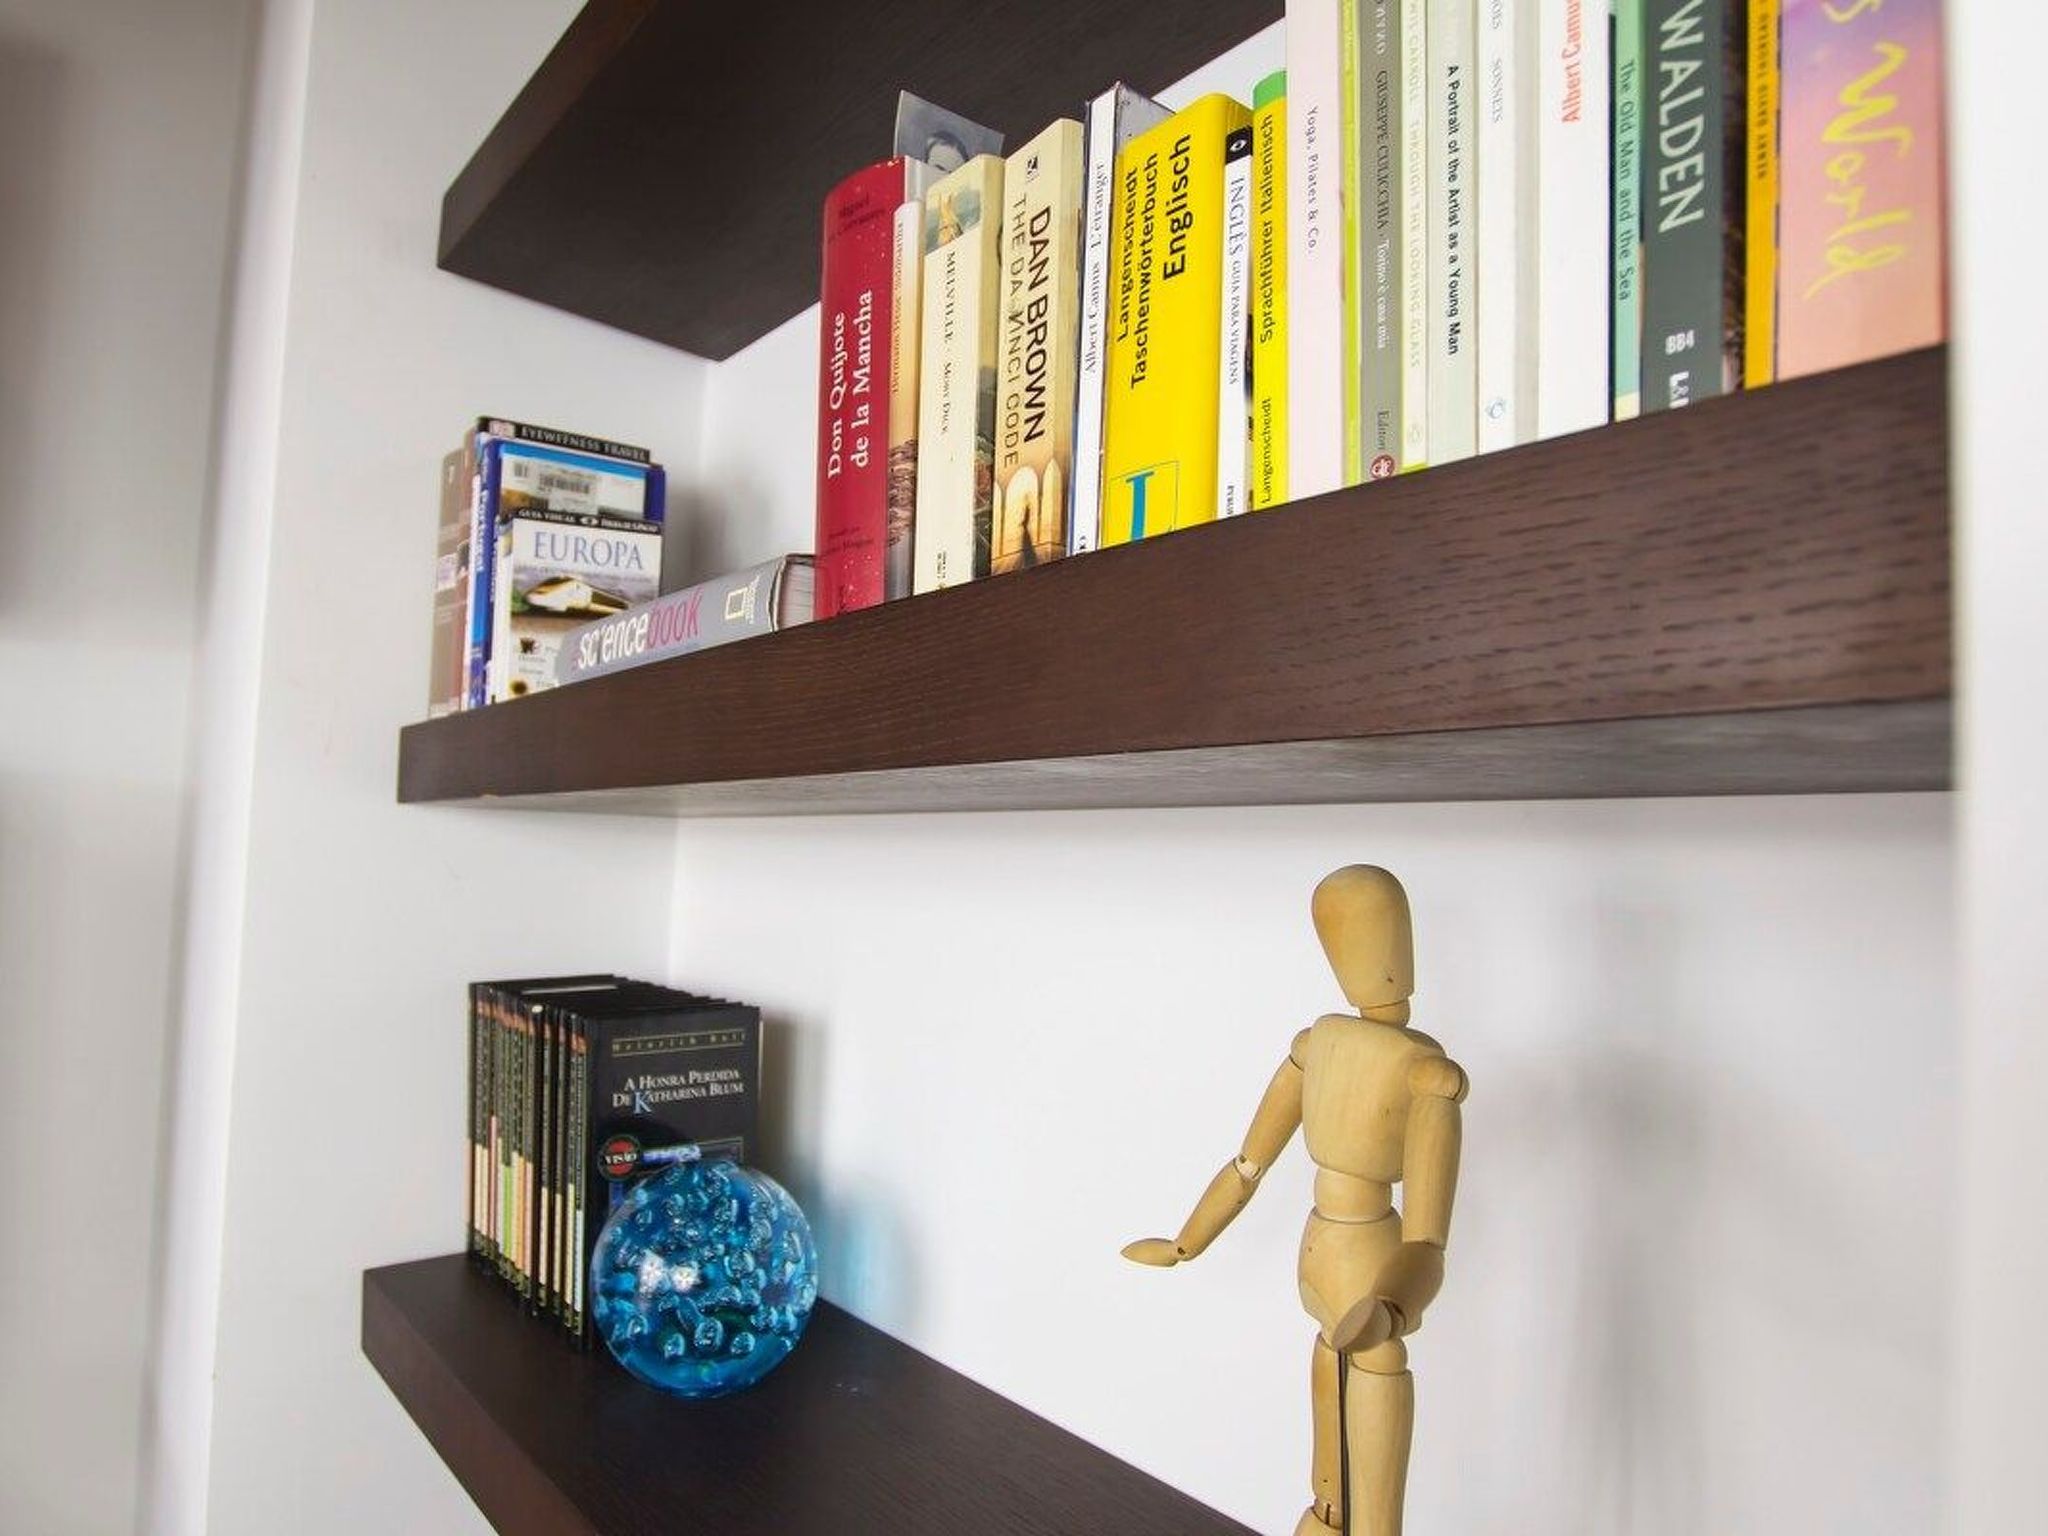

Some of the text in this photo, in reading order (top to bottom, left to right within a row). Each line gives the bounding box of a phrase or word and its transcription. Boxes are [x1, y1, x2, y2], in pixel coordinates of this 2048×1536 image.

[1561, 0, 1582, 124] Albert Camu
[1658, 0, 1705, 233] WALDEN
[1162, 134, 1193, 281] Englisch
[1260, 114, 1276, 344] Sprachführer Italienisch
[1307, 153, 1319, 204] Pilates
[1307, 208, 1319, 221] &
[1447, 65, 1461, 355] A Portrait of the Artist as a Young Man
[1619, 61, 1637, 300] The Old Man and the Sea
[1803, 41, 1915, 300] World
[1029, 205, 1051, 291] DAN
[1087, 261, 1100, 319] Camus
[1117, 167, 1139, 343] Langenscheidt
[1130, 152, 1159, 389] Taschenwörterbuch
[827, 311, 849, 479] Don Quijote
[850, 289, 873, 468] de la Mancha
[1004, 193, 1027, 468] THE DA VINCI CODE
[1023, 294, 1049, 443] BROWN
[1085, 322, 1098, 374] Albert
[521, 426, 602, 451] EYEWITNESS
[534, 530, 644, 570] EUROPA
[624, 1078, 636, 1091] A
